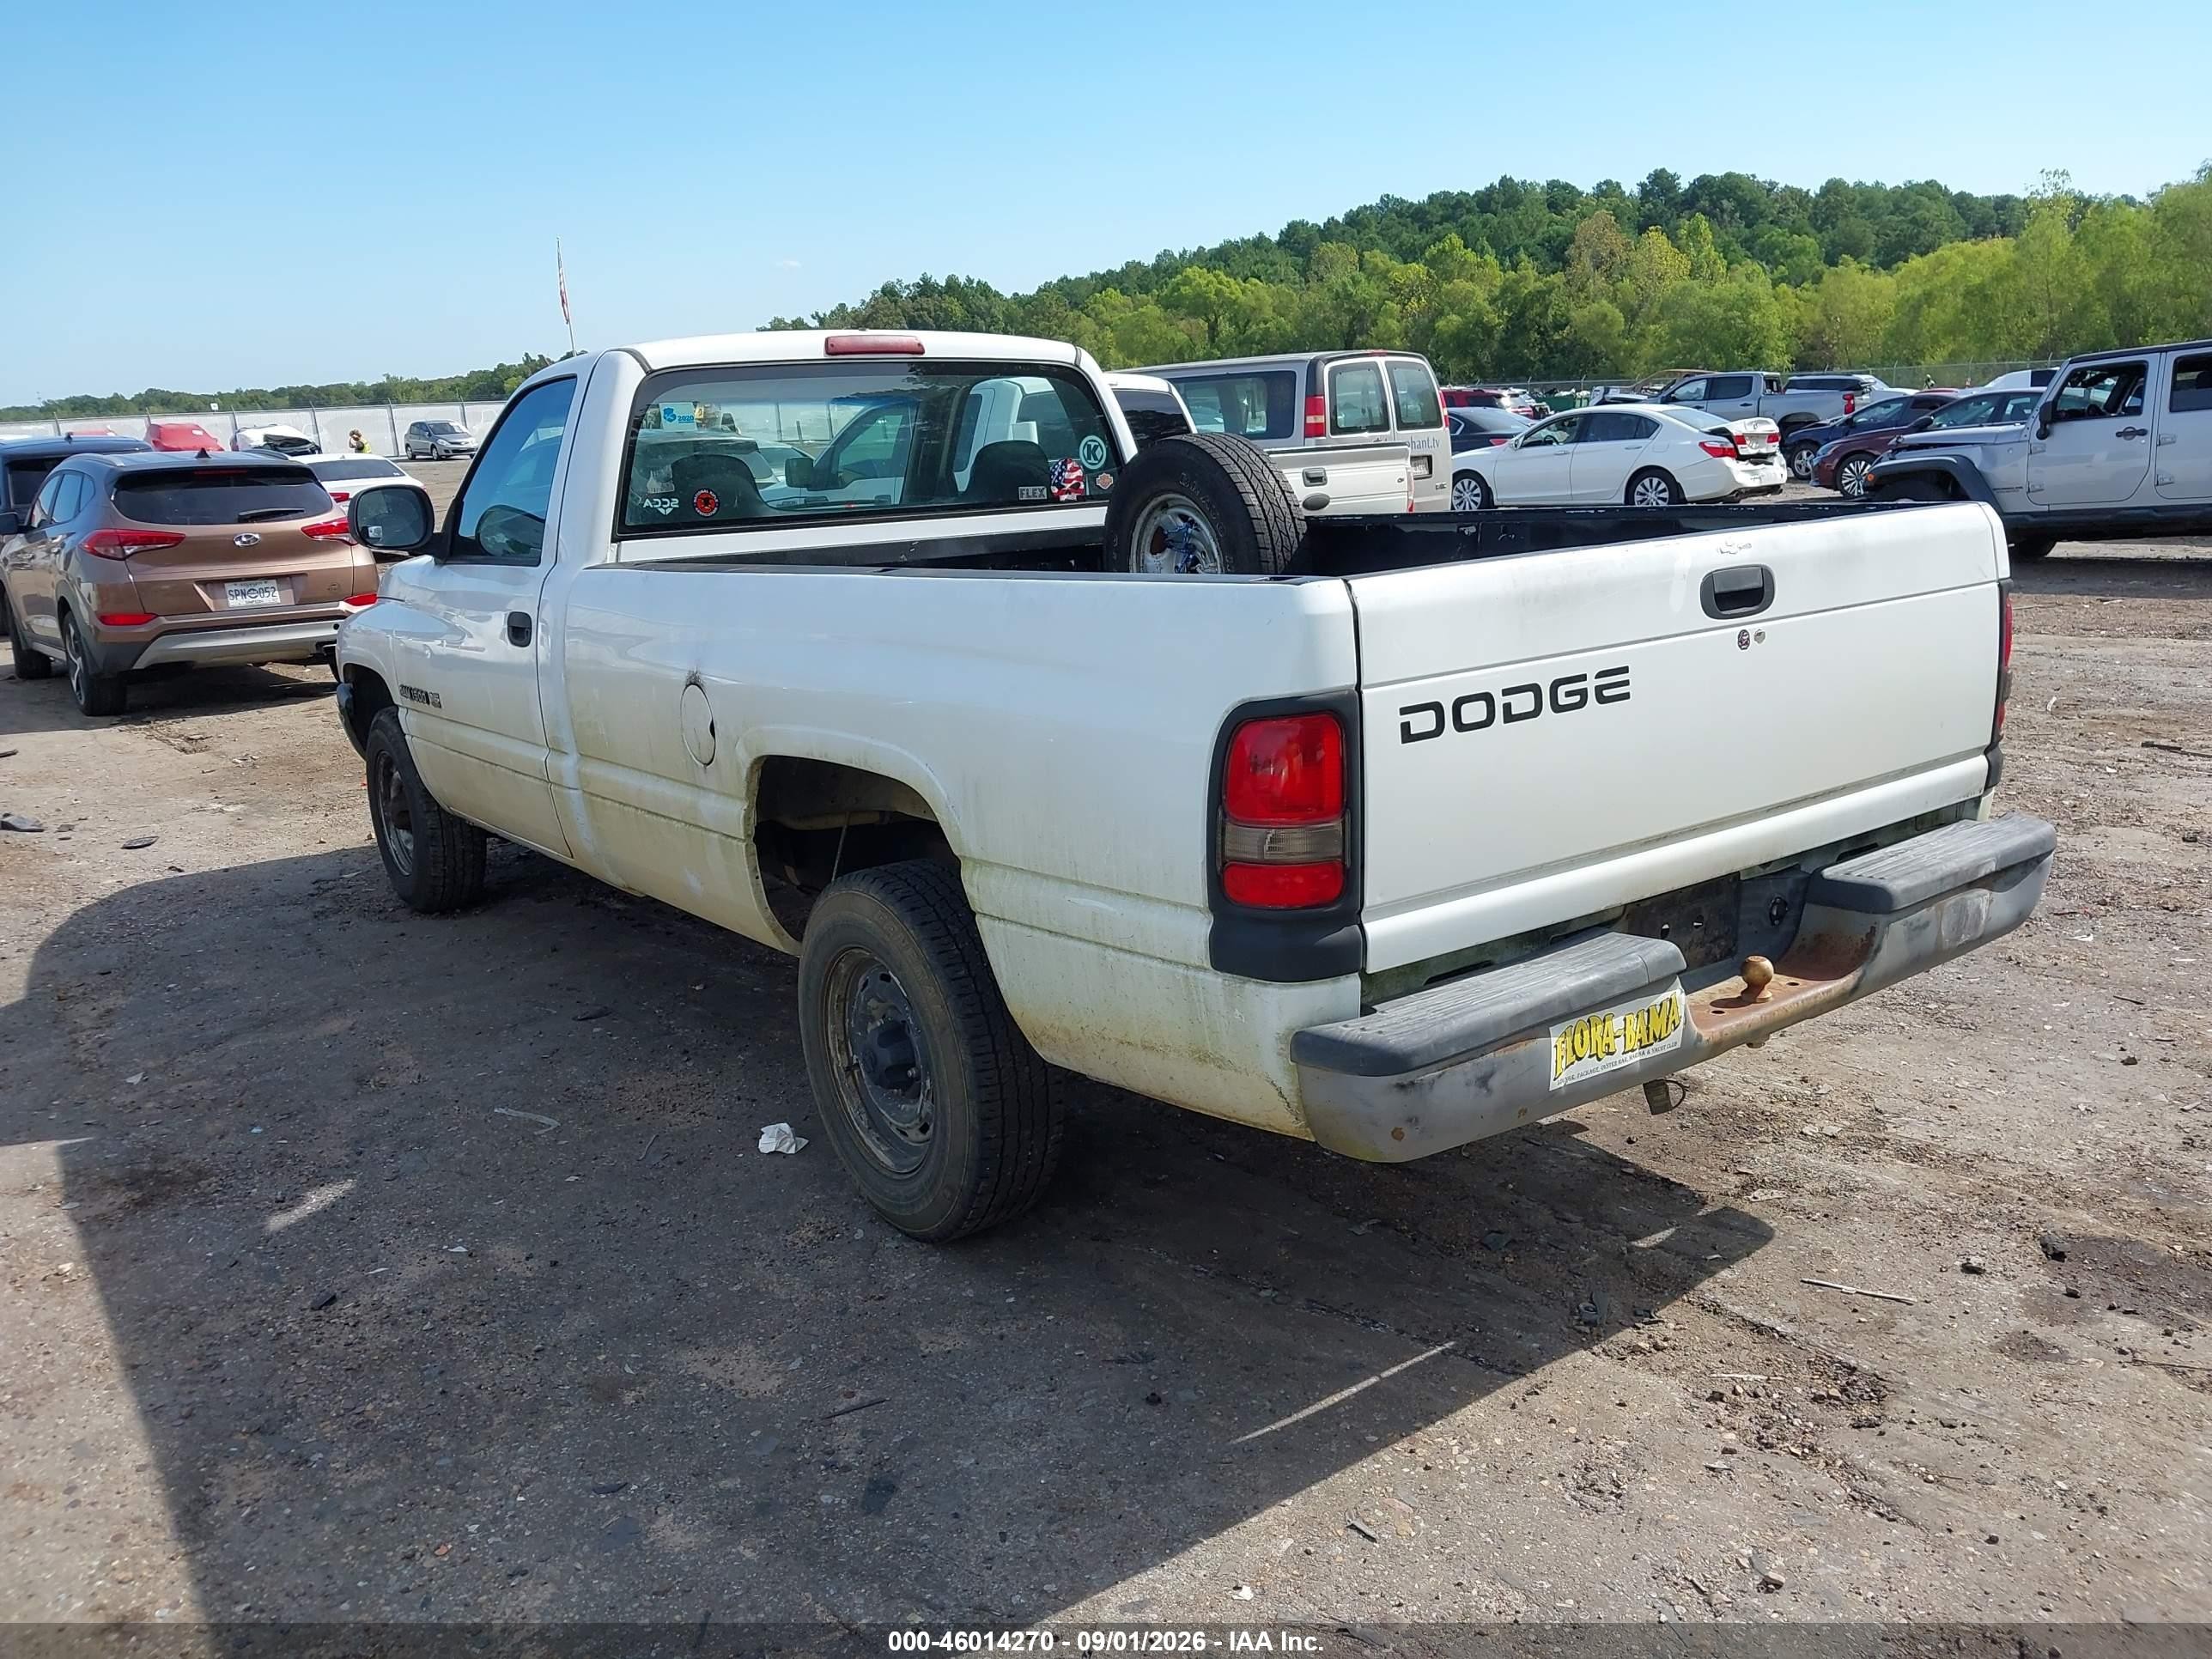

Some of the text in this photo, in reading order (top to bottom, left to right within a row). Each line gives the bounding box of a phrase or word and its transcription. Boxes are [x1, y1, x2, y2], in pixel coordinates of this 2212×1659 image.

[1019, 487, 1046, 498] FLEX
[228, 586, 277, 600] SPN 052
[1399, 665, 1631, 744] DODGE
[1553, 993, 1681, 1081] FLORA-BAMA
